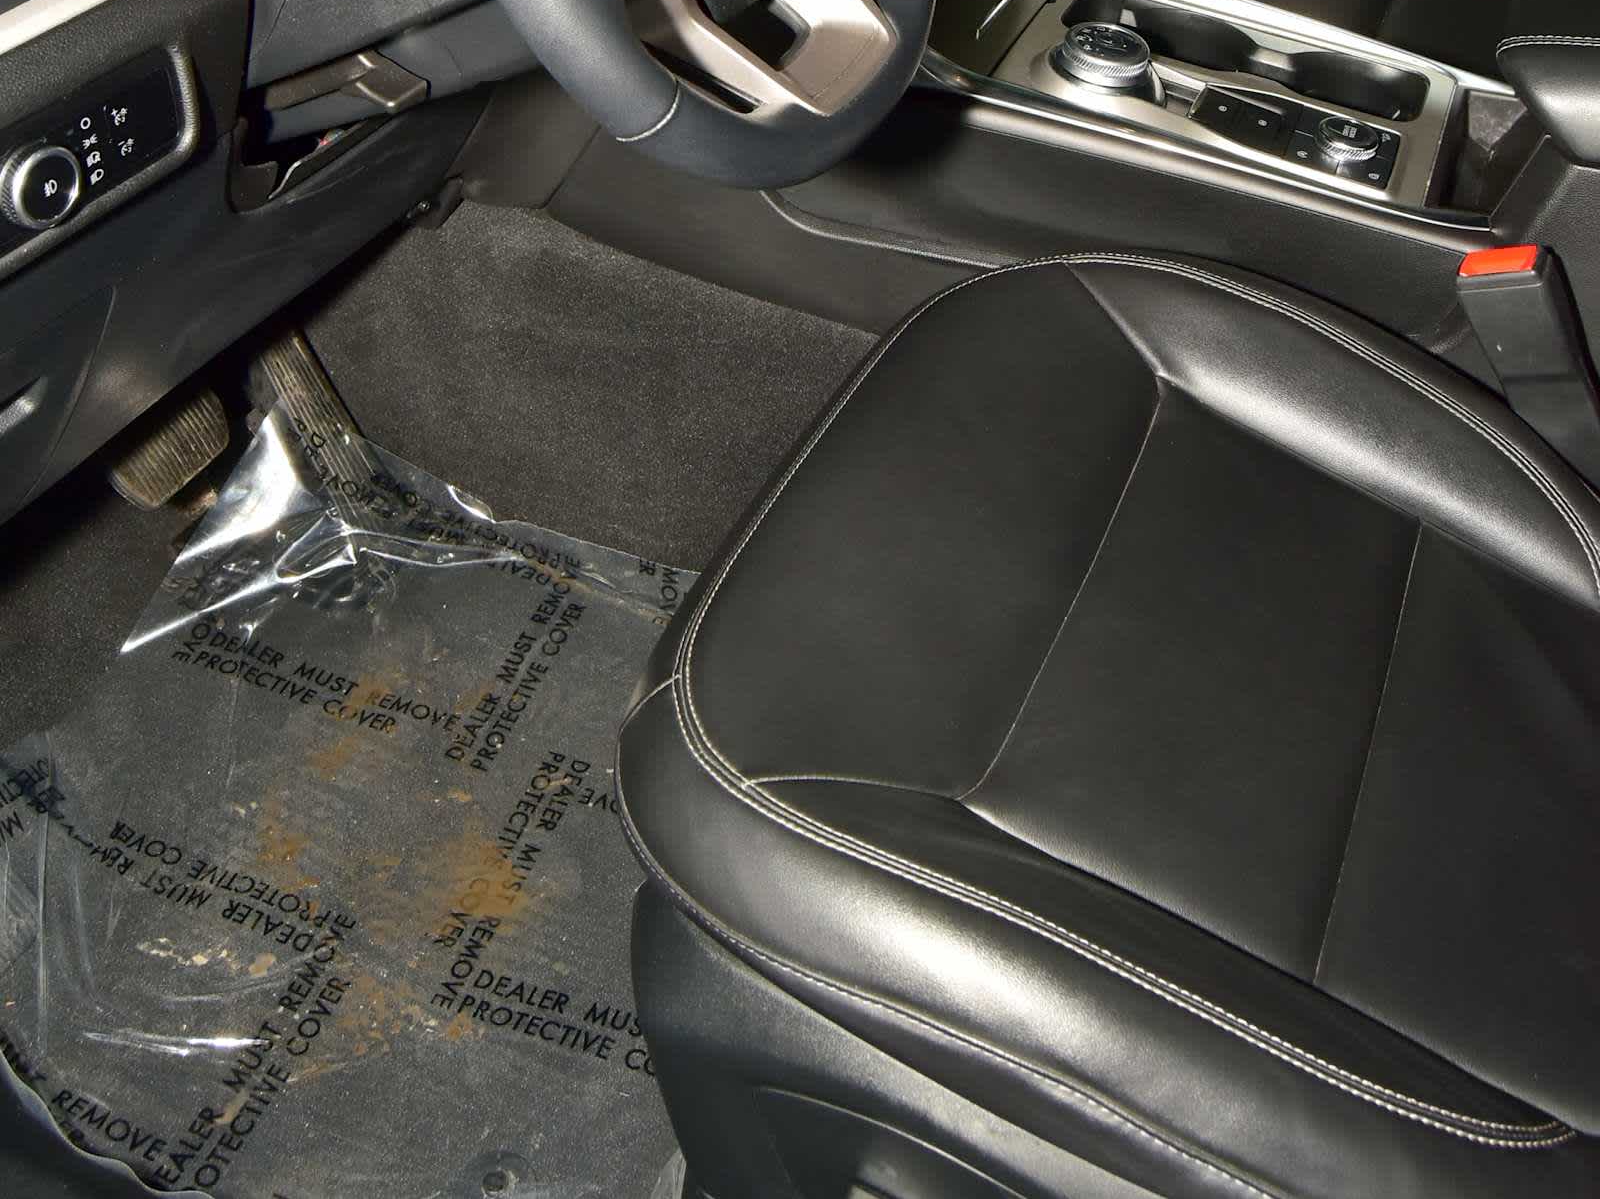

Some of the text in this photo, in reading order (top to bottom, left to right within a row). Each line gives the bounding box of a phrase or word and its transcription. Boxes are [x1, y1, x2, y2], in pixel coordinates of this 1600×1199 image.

[193, 651, 398, 734] PROTECTIVE COVER
[209, 627, 462, 732] DEALER MUST REMOVE
[444, 557, 581, 762] DEALER MUST REMOVE
[470, 603, 588, 773] PROTECTIVE COVER
[539, 758, 591, 832] DEALER
[109, 820, 333, 929] PROTECTIVE COVER
[140, 869, 213, 910] MUST
[221, 899, 315, 952] DEALER
[430, 915, 500, 1008] REMOVE
[222, 1021, 282, 1094] MUST
[279, 913, 357, 1013] REMOVE
[286, 976, 352, 1057] COVER
[457, 994, 616, 1060] PROTECTIVE
[473, 969, 642, 1037] DEALER MUS
[51, 1089, 168, 1162] REMOVE
